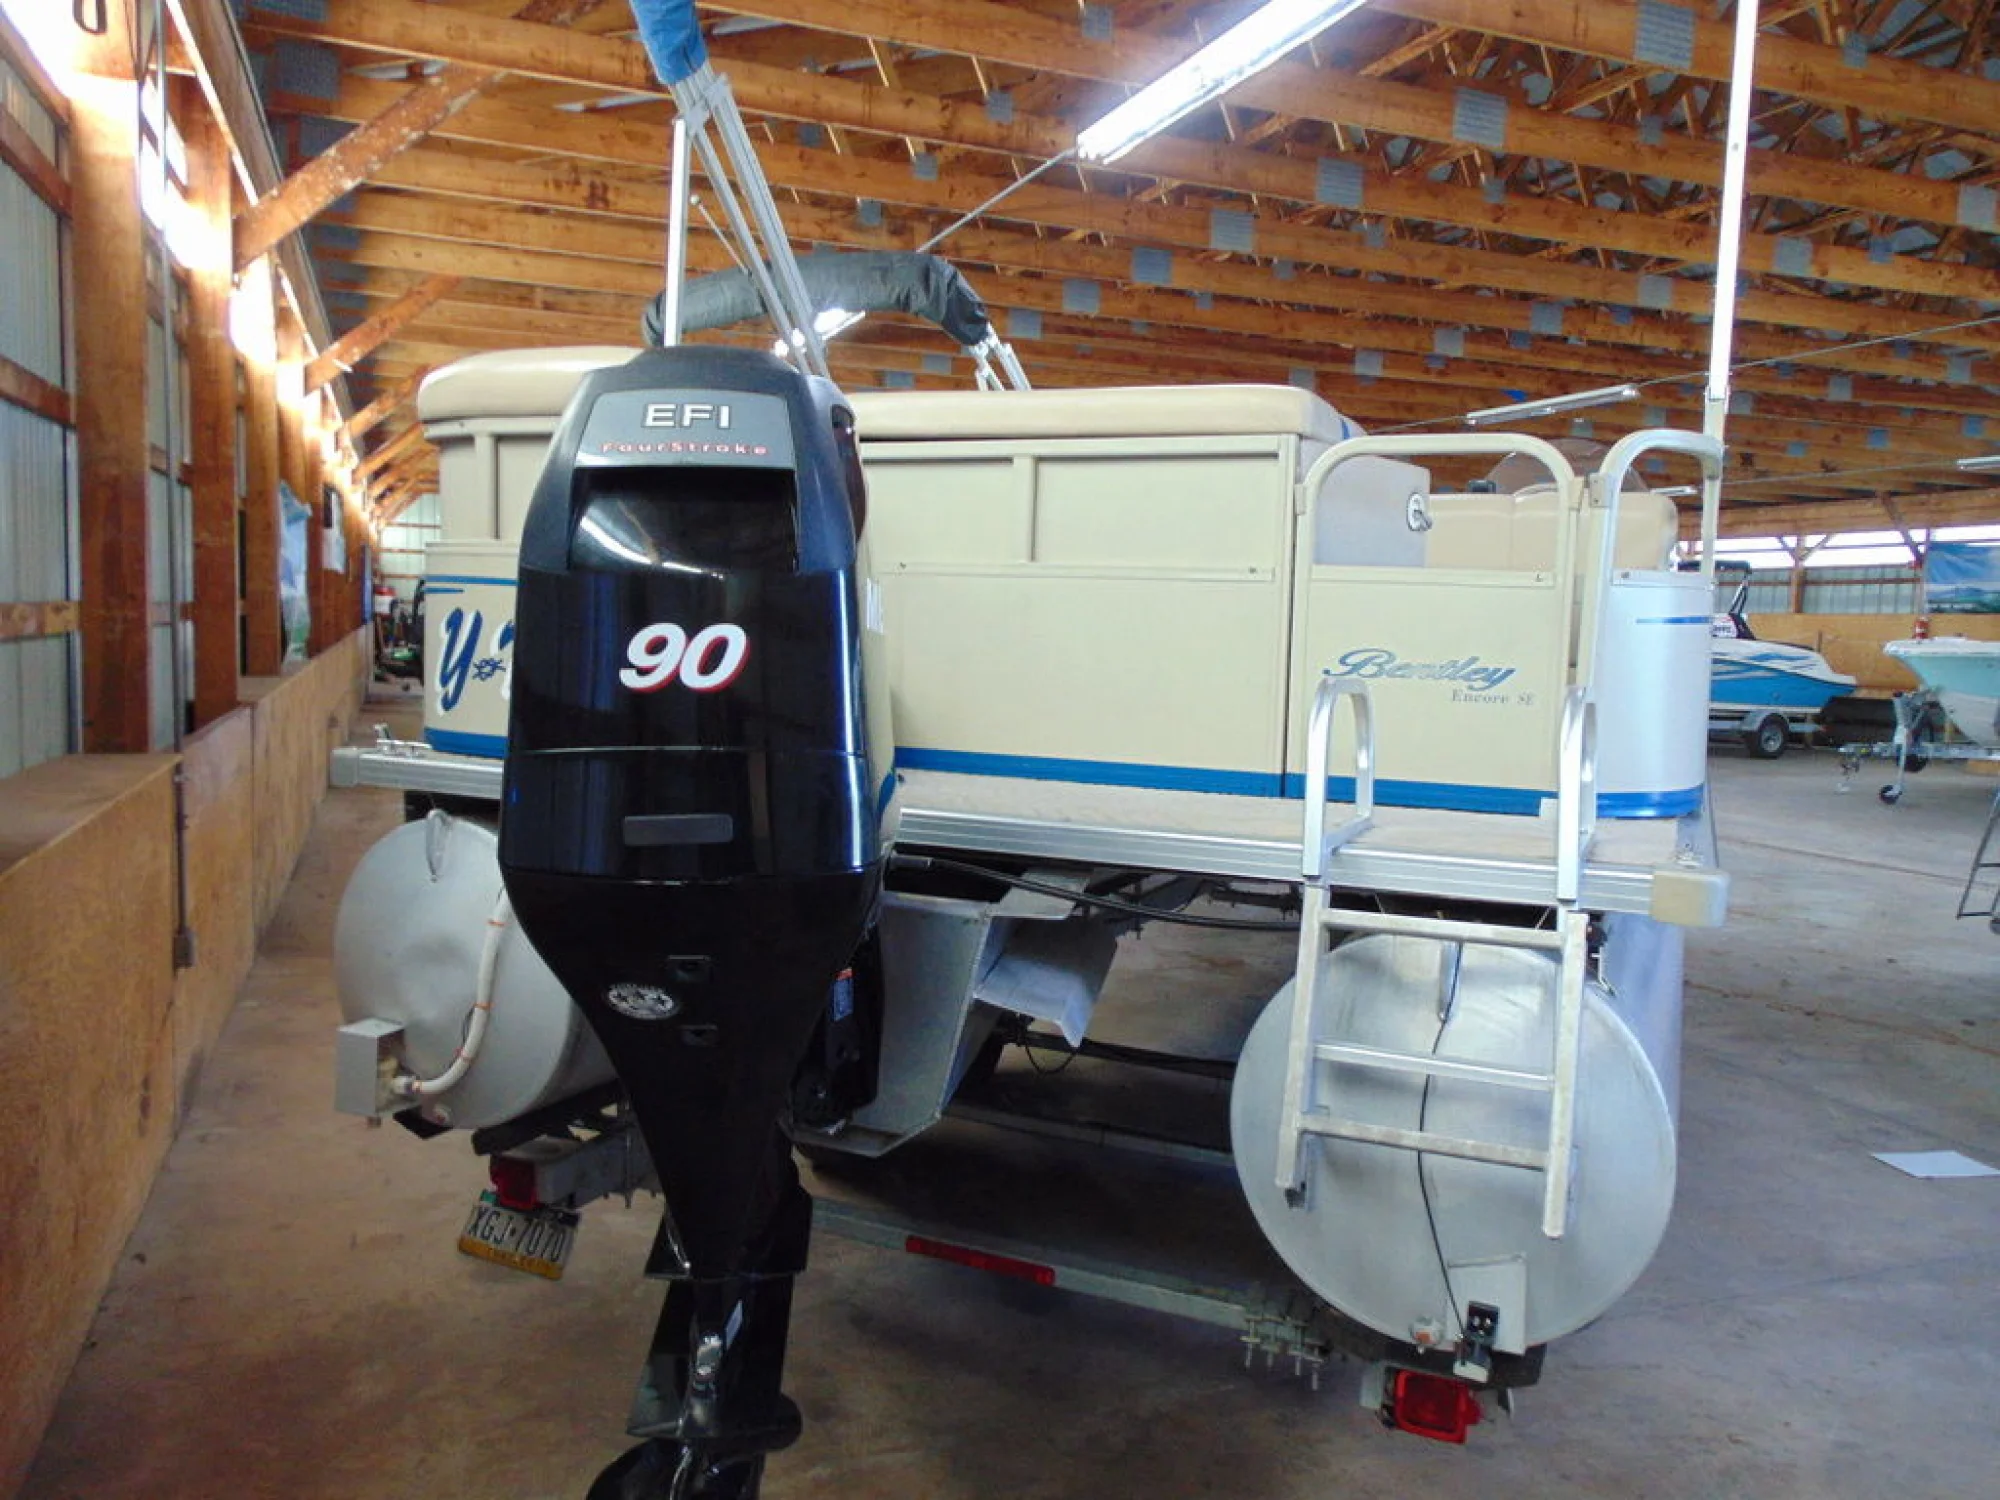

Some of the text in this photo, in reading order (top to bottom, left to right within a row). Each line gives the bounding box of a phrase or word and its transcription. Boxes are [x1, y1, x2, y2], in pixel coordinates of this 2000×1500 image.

[643, 403, 732, 430] EFI
[601, 441, 769, 456] FourStroke
[618, 622, 750, 694] 90
[1322, 648, 1517, 692] Bentley
[1451, 689, 1510, 705] Encore
